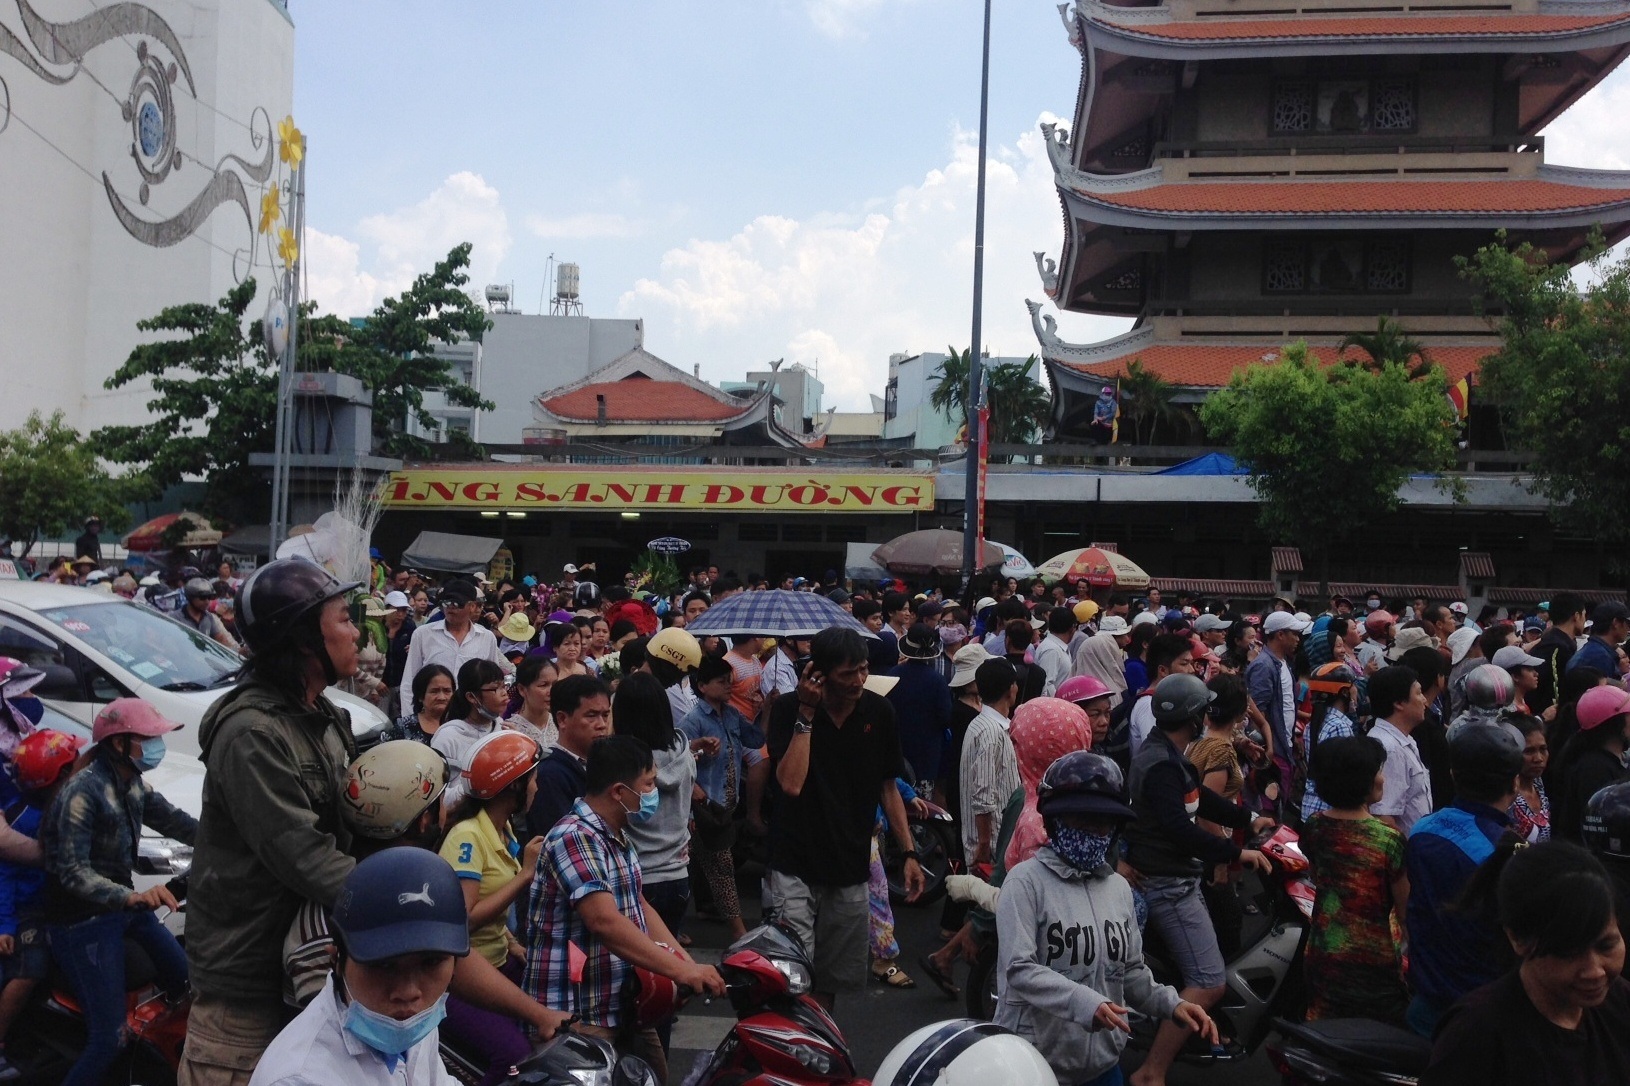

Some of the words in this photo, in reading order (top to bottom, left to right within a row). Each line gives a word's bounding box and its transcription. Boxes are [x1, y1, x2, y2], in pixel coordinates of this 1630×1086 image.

[514, 481, 691, 504] SANH
[699, 479, 924, 506] ĐƯỜNG
[660, 644, 686, 662] CSGT
[458, 842, 473, 864] 3
